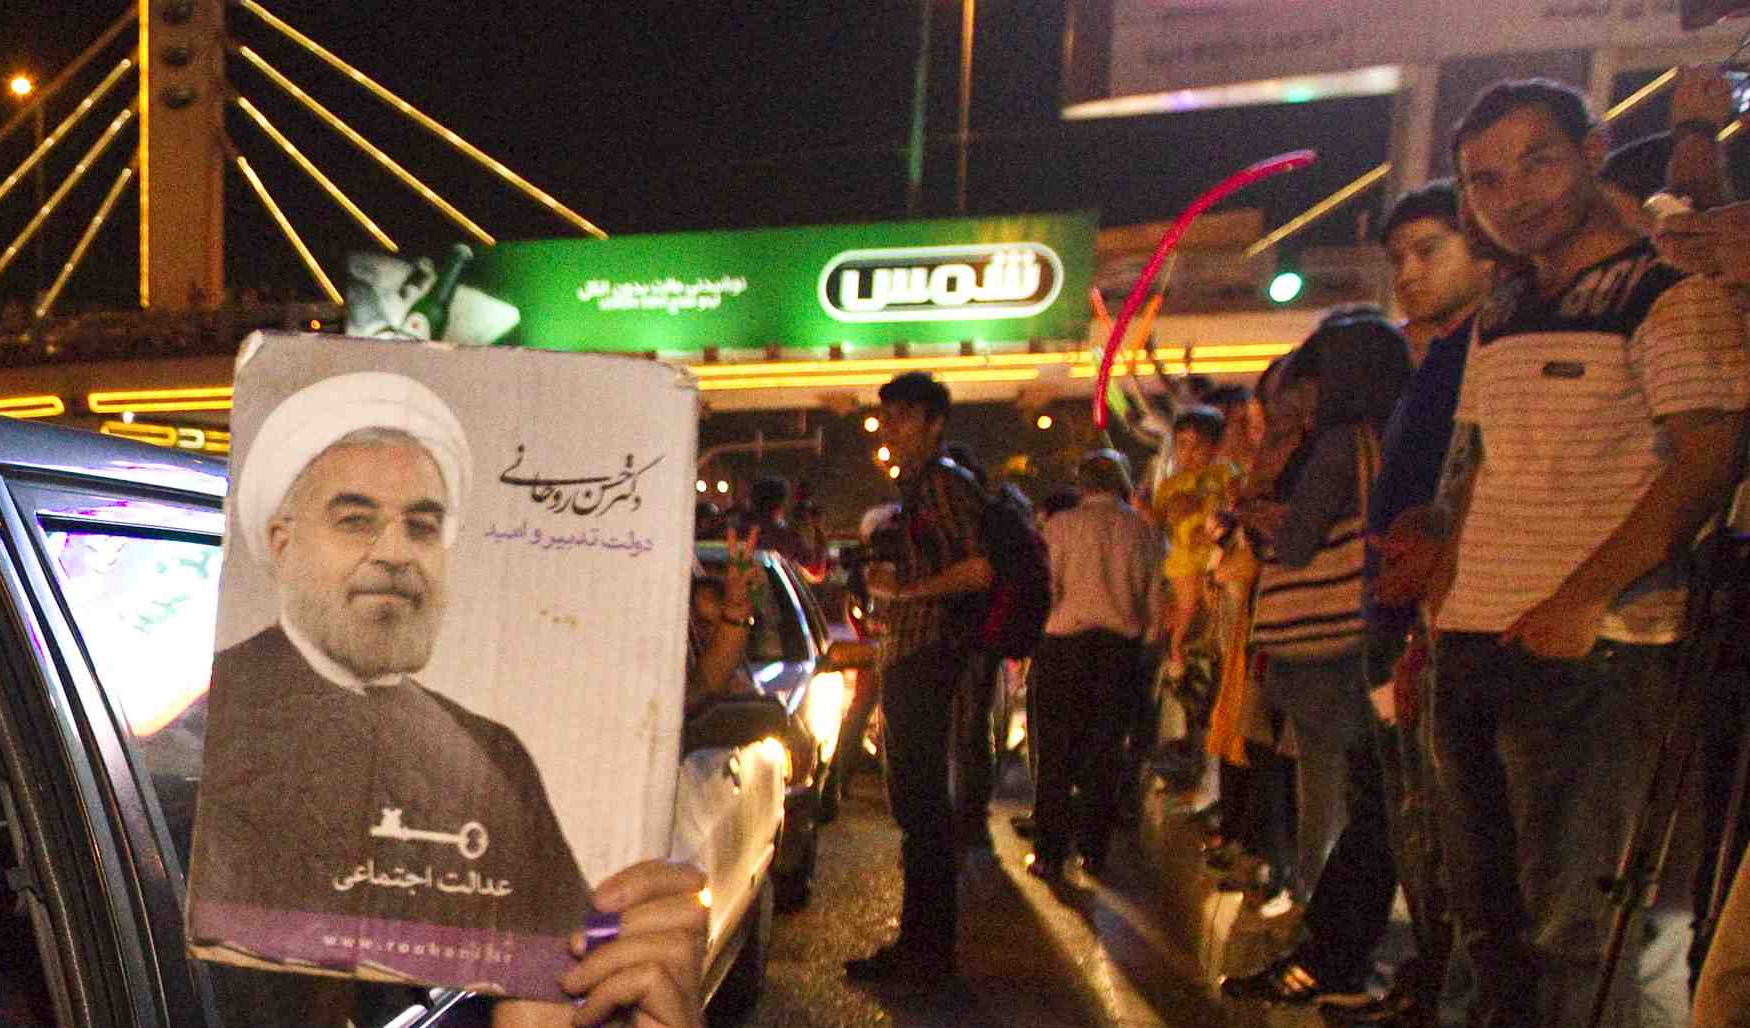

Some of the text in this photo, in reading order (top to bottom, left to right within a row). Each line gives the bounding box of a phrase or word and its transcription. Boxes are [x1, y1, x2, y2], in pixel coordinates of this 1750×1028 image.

[840, 248, 1043, 309] شمس
[485, 521, 527, 543] امید
[542, 527, 600, 550] تدبیر
[602, 529, 654, 557] دولت
[331, 857, 514, 897] عدالت اجتماعی
